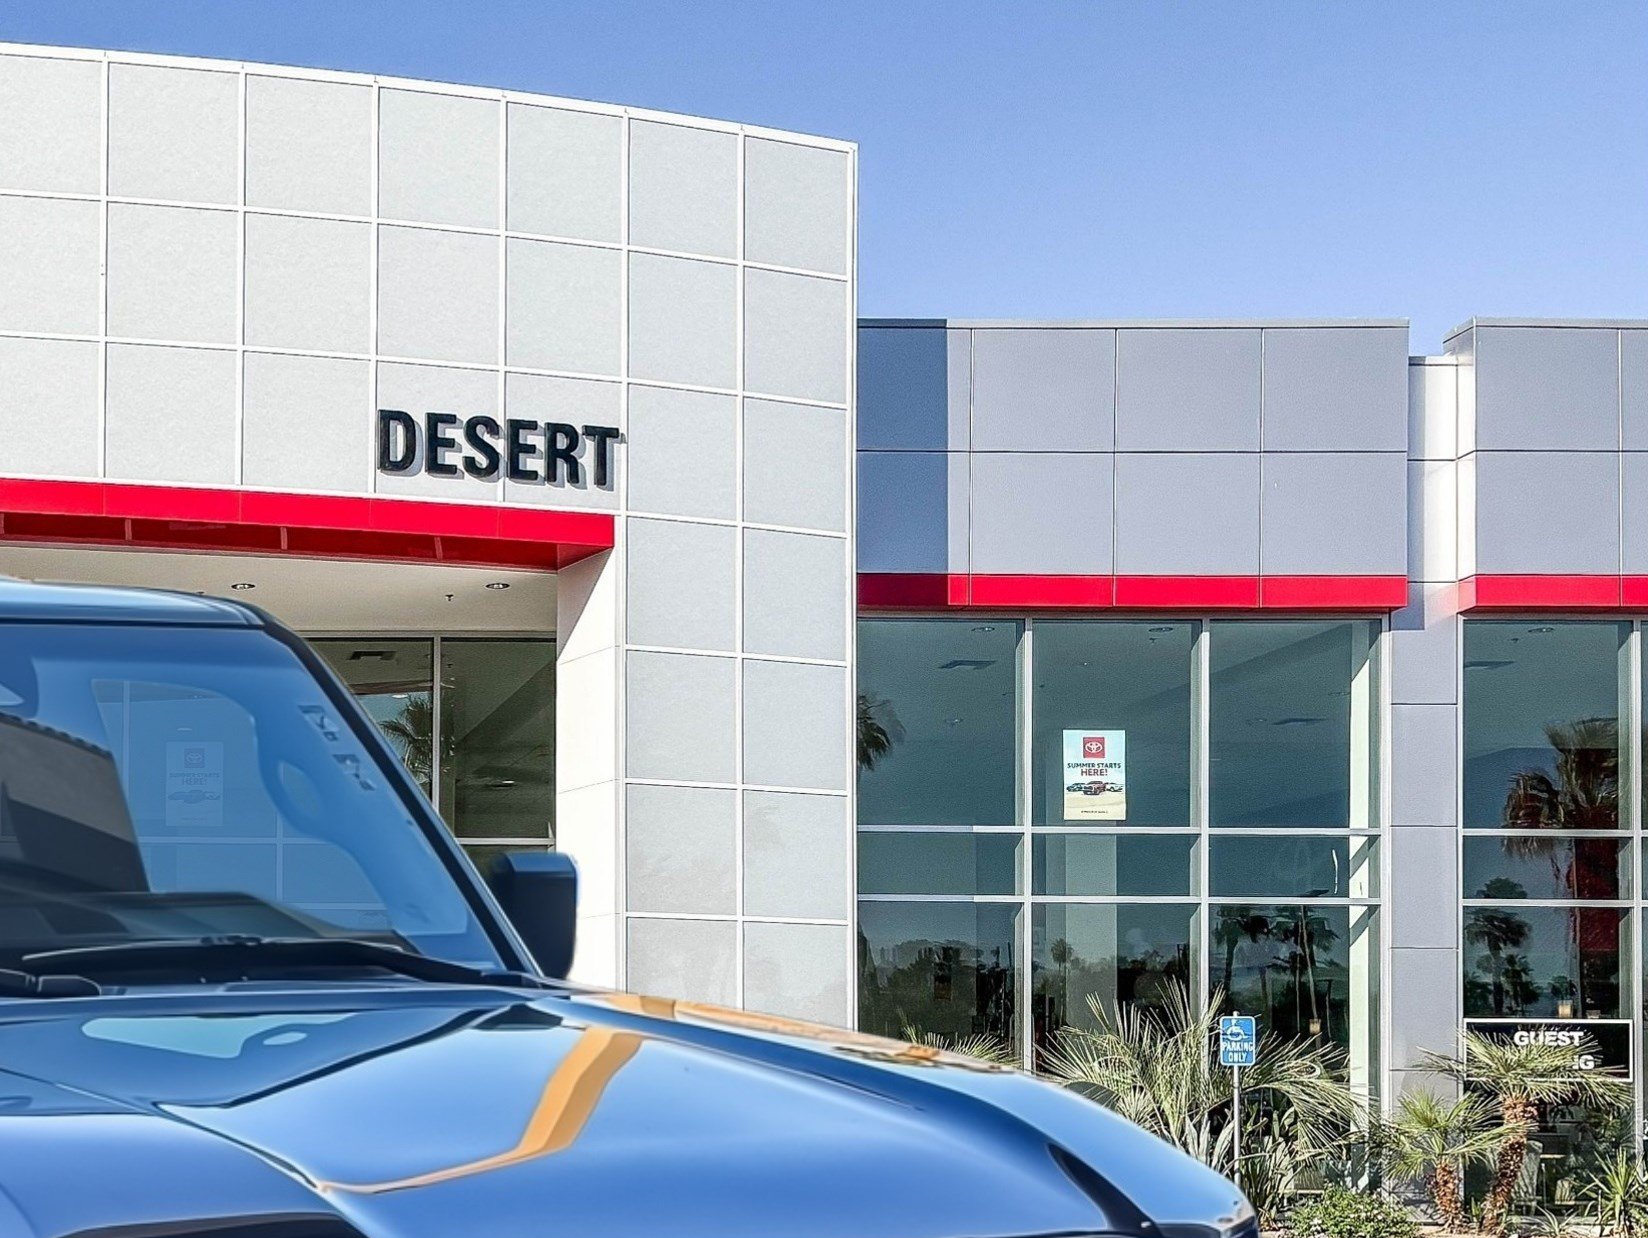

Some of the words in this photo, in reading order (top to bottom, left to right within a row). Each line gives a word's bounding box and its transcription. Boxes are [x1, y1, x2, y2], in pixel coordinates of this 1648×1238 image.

[376, 409, 621, 486] DESERT
[1081, 768, 1108, 777] HERE!
[1513, 1031, 1585, 1047] GUEST
[1222, 1041, 1254, 1052] PARKING
[1228, 1052, 1248, 1062] ONLY
